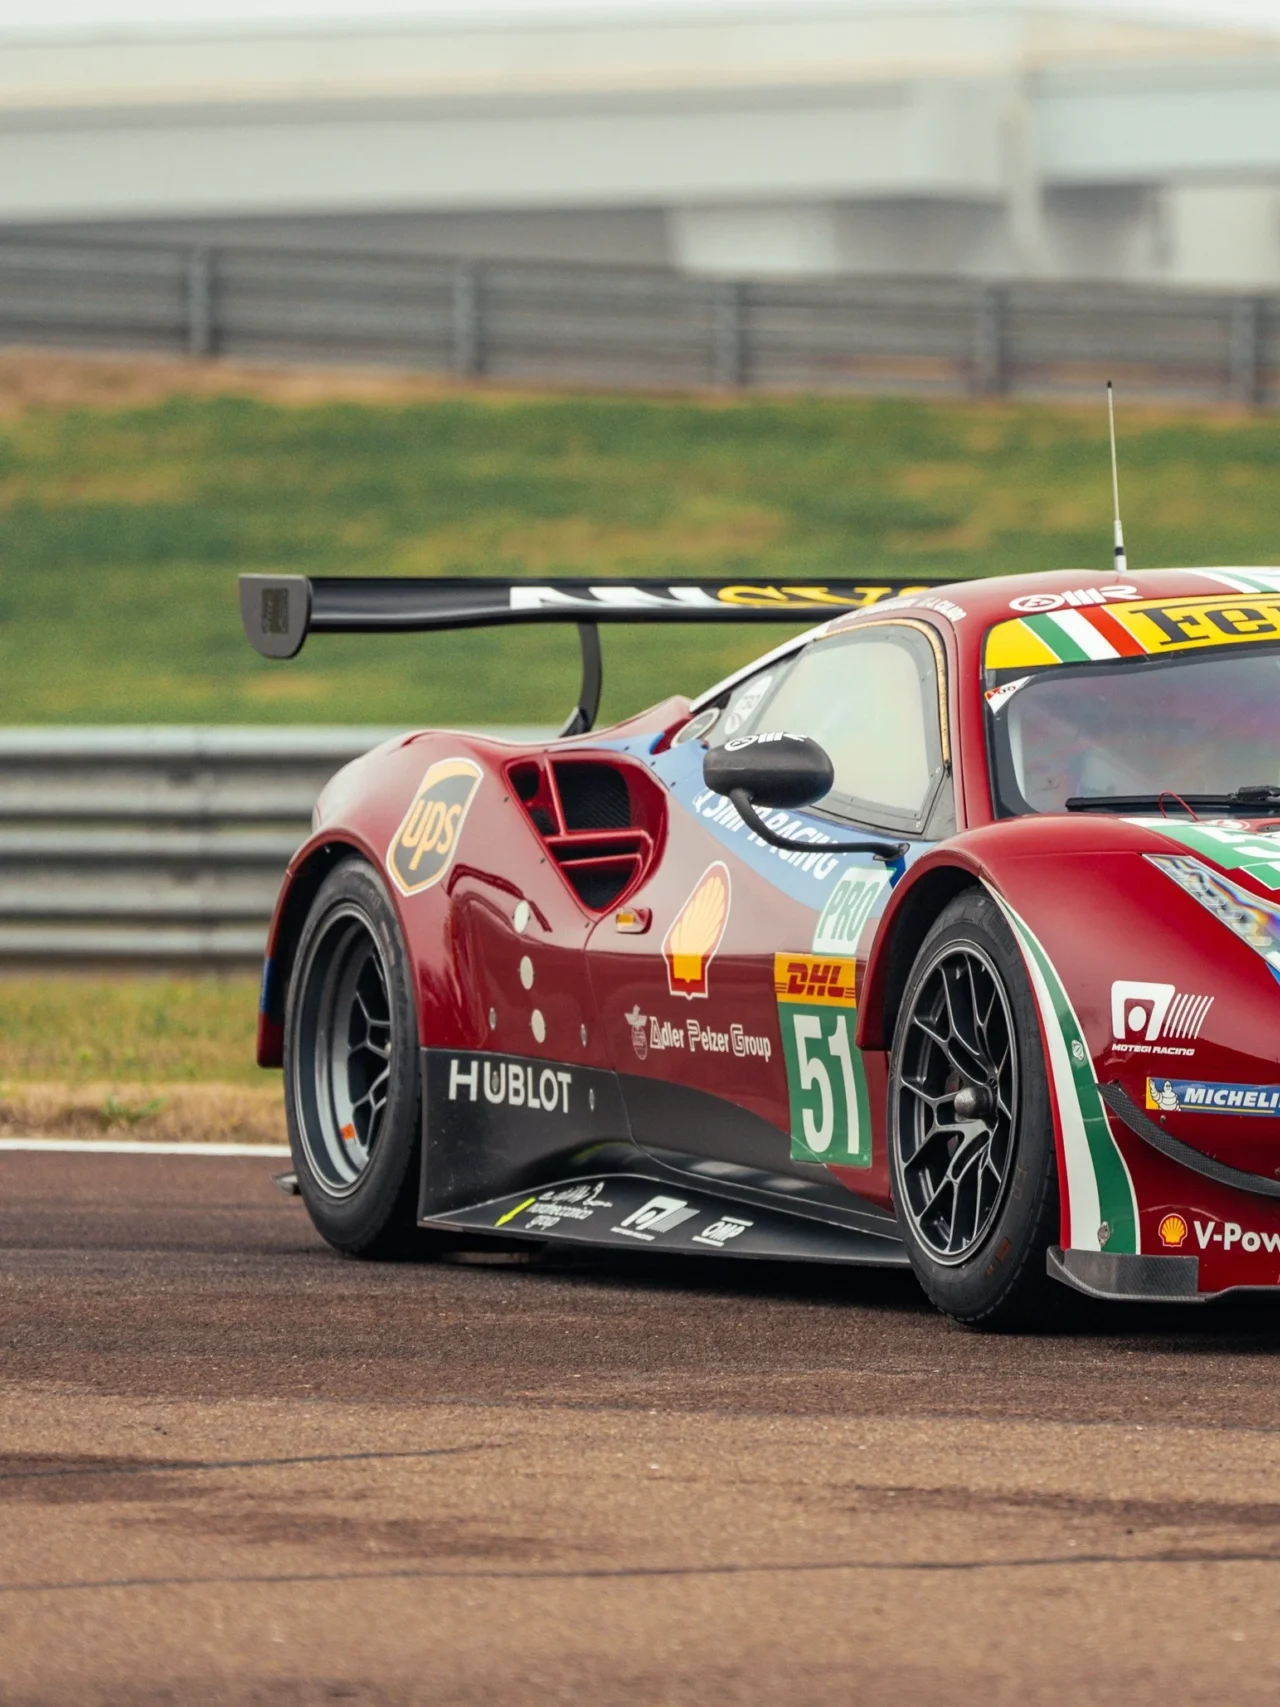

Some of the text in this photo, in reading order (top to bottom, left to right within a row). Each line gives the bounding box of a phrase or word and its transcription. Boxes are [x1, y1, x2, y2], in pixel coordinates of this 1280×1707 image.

[402, 799, 462, 871] ups
[817, 880, 881, 941] PRO
[787, 962, 845, 998] DHL
[649, 1016, 772, 1063] Adler Pelzer Group
[1111, 1043, 1195, 1056] MOTEGI RACING
[448, 1059, 572, 1114] HUBLOT
[793, 1014, 860, 1155] 51
